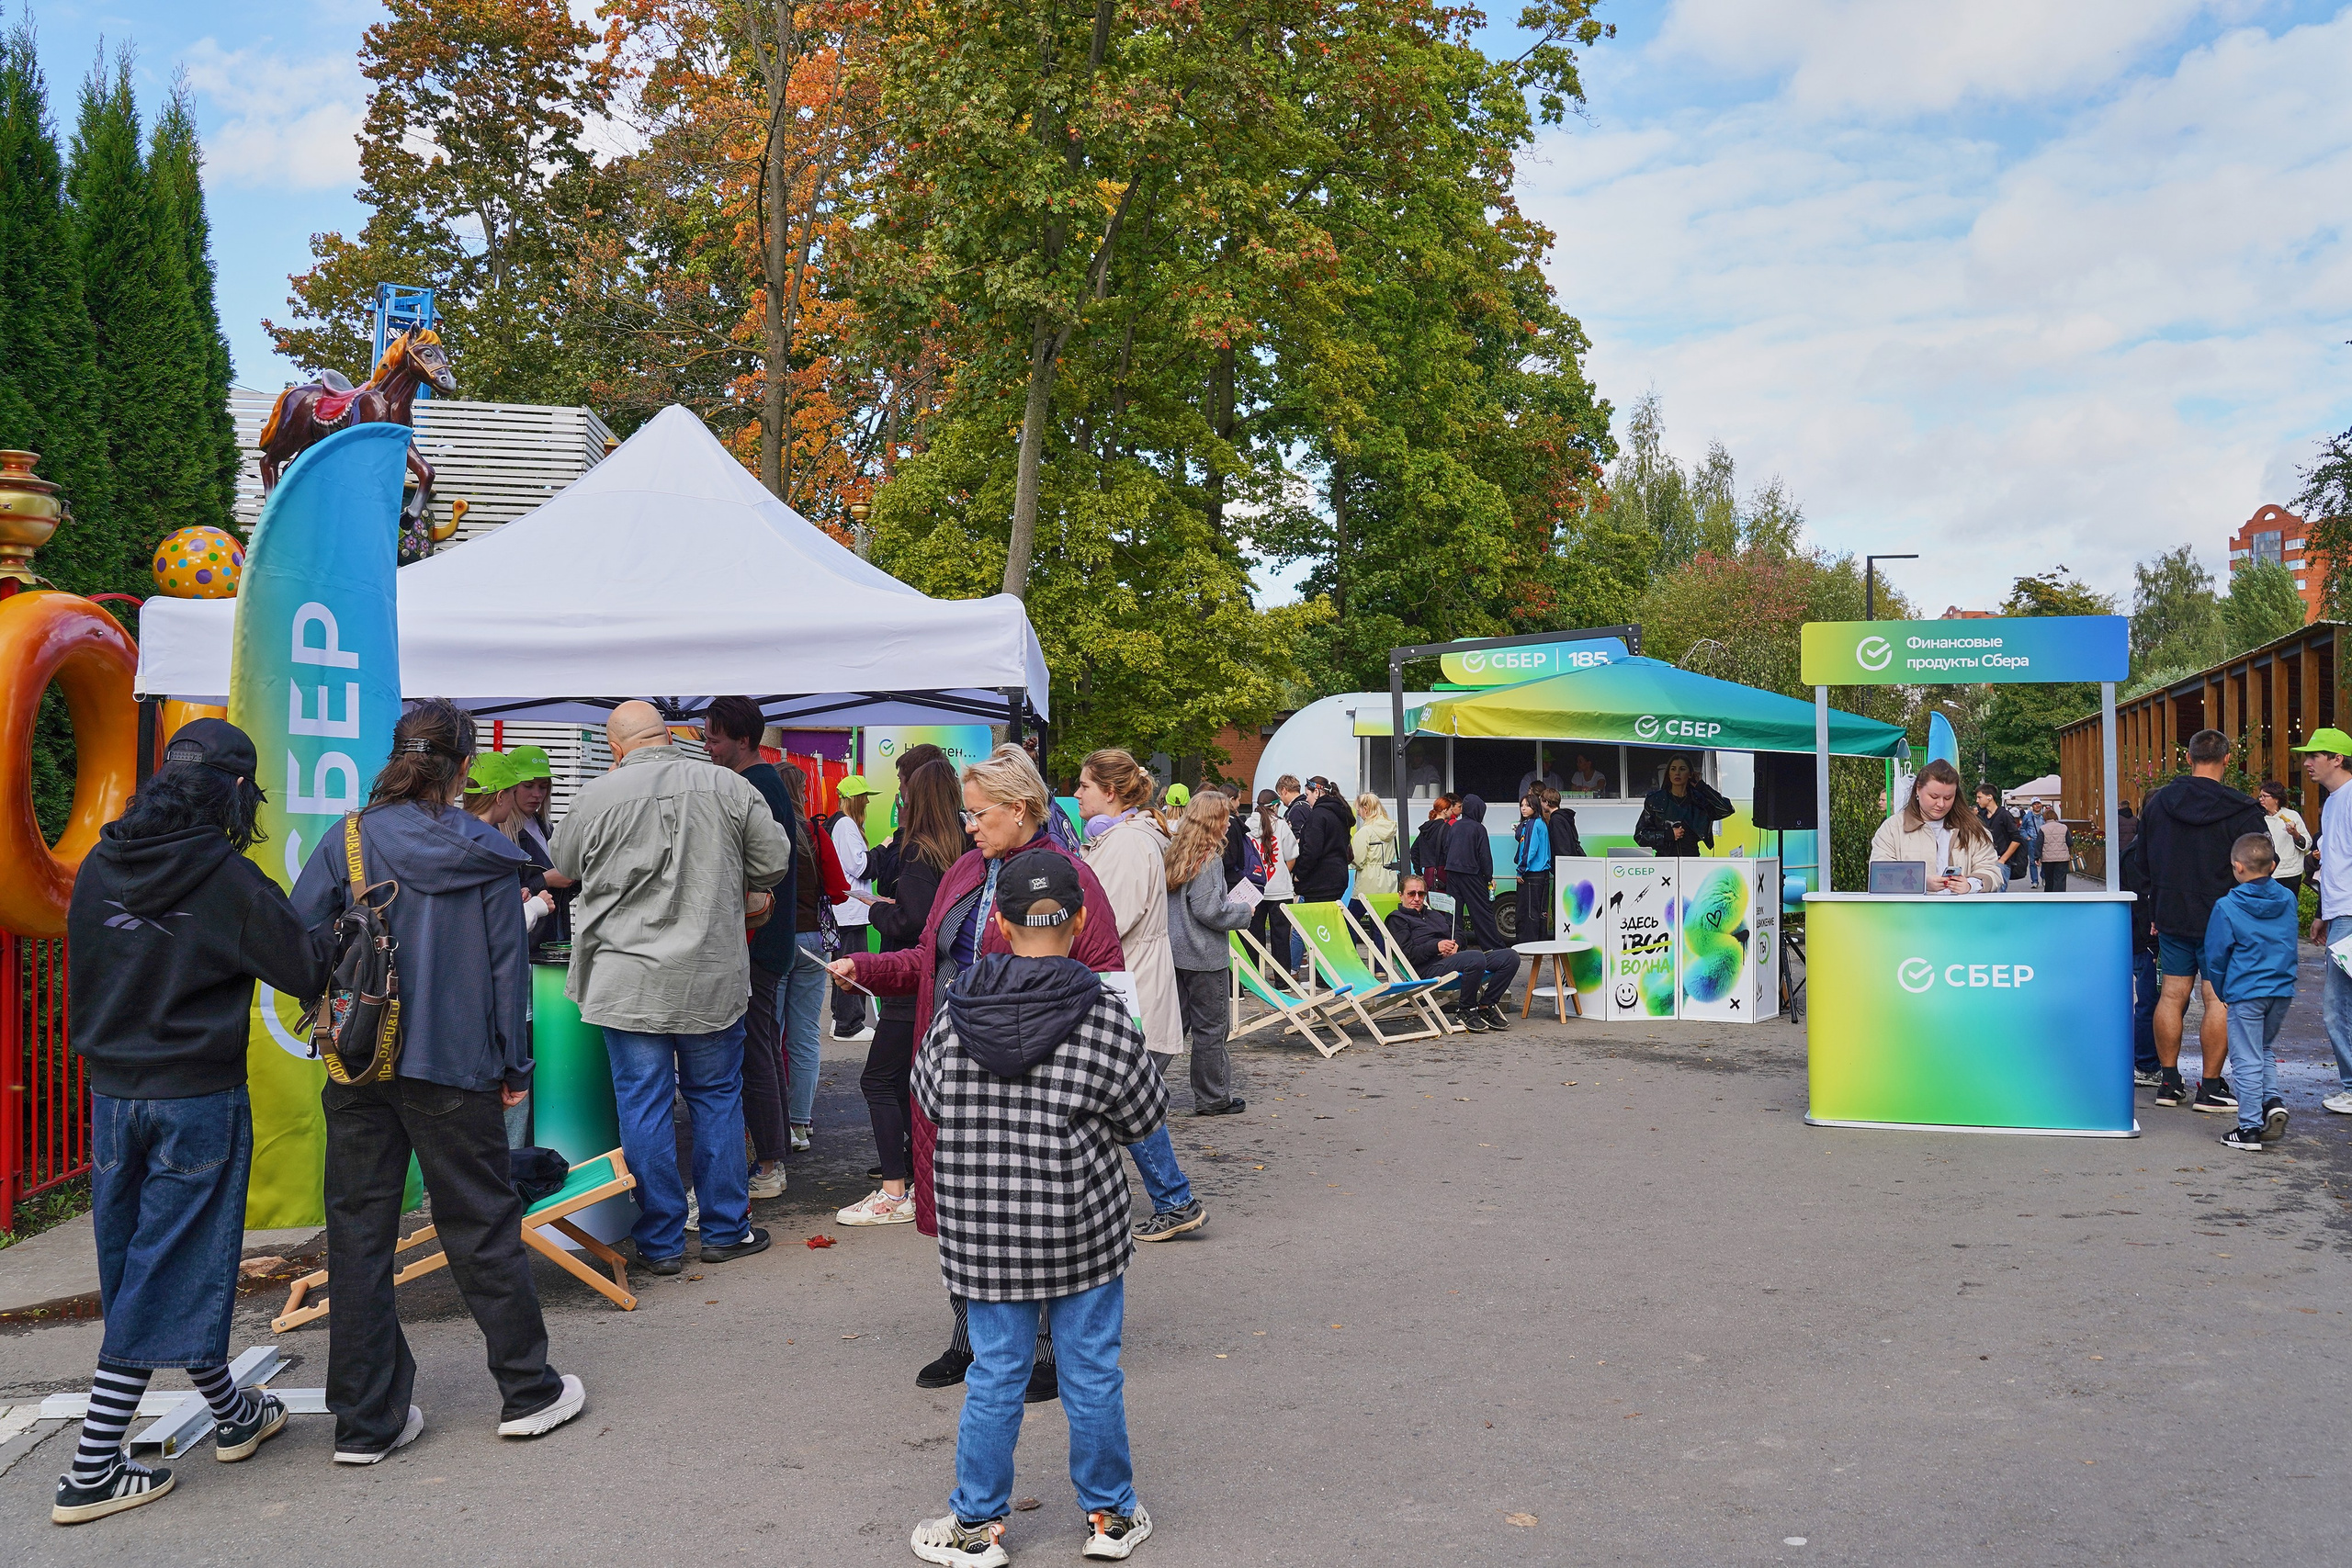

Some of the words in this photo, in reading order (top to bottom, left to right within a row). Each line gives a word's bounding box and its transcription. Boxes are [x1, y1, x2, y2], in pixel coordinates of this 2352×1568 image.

[1905, 636, 2003, 649] Финансовые
[1491, 652, 1547, 669] СБЕР
[1568, 650, 1609, 668] 185
[1906, 658, 1979, 671] продукты
[1981, 653, 2030, 670] Сбера
[1665, 719, 1722, 739] СБЕР
[283, 602, 360, 885] БЕР
[1627, 867, 1655, 876] СБЕР
[1620, 916, 1659, 931] ЗДЕСЬ
[1621, 932, 1669, 955] ТВОЯ
[1621, 958, 1670, 976] ВОЛНА
[1944, 964, 2035, 988] СБЕР
